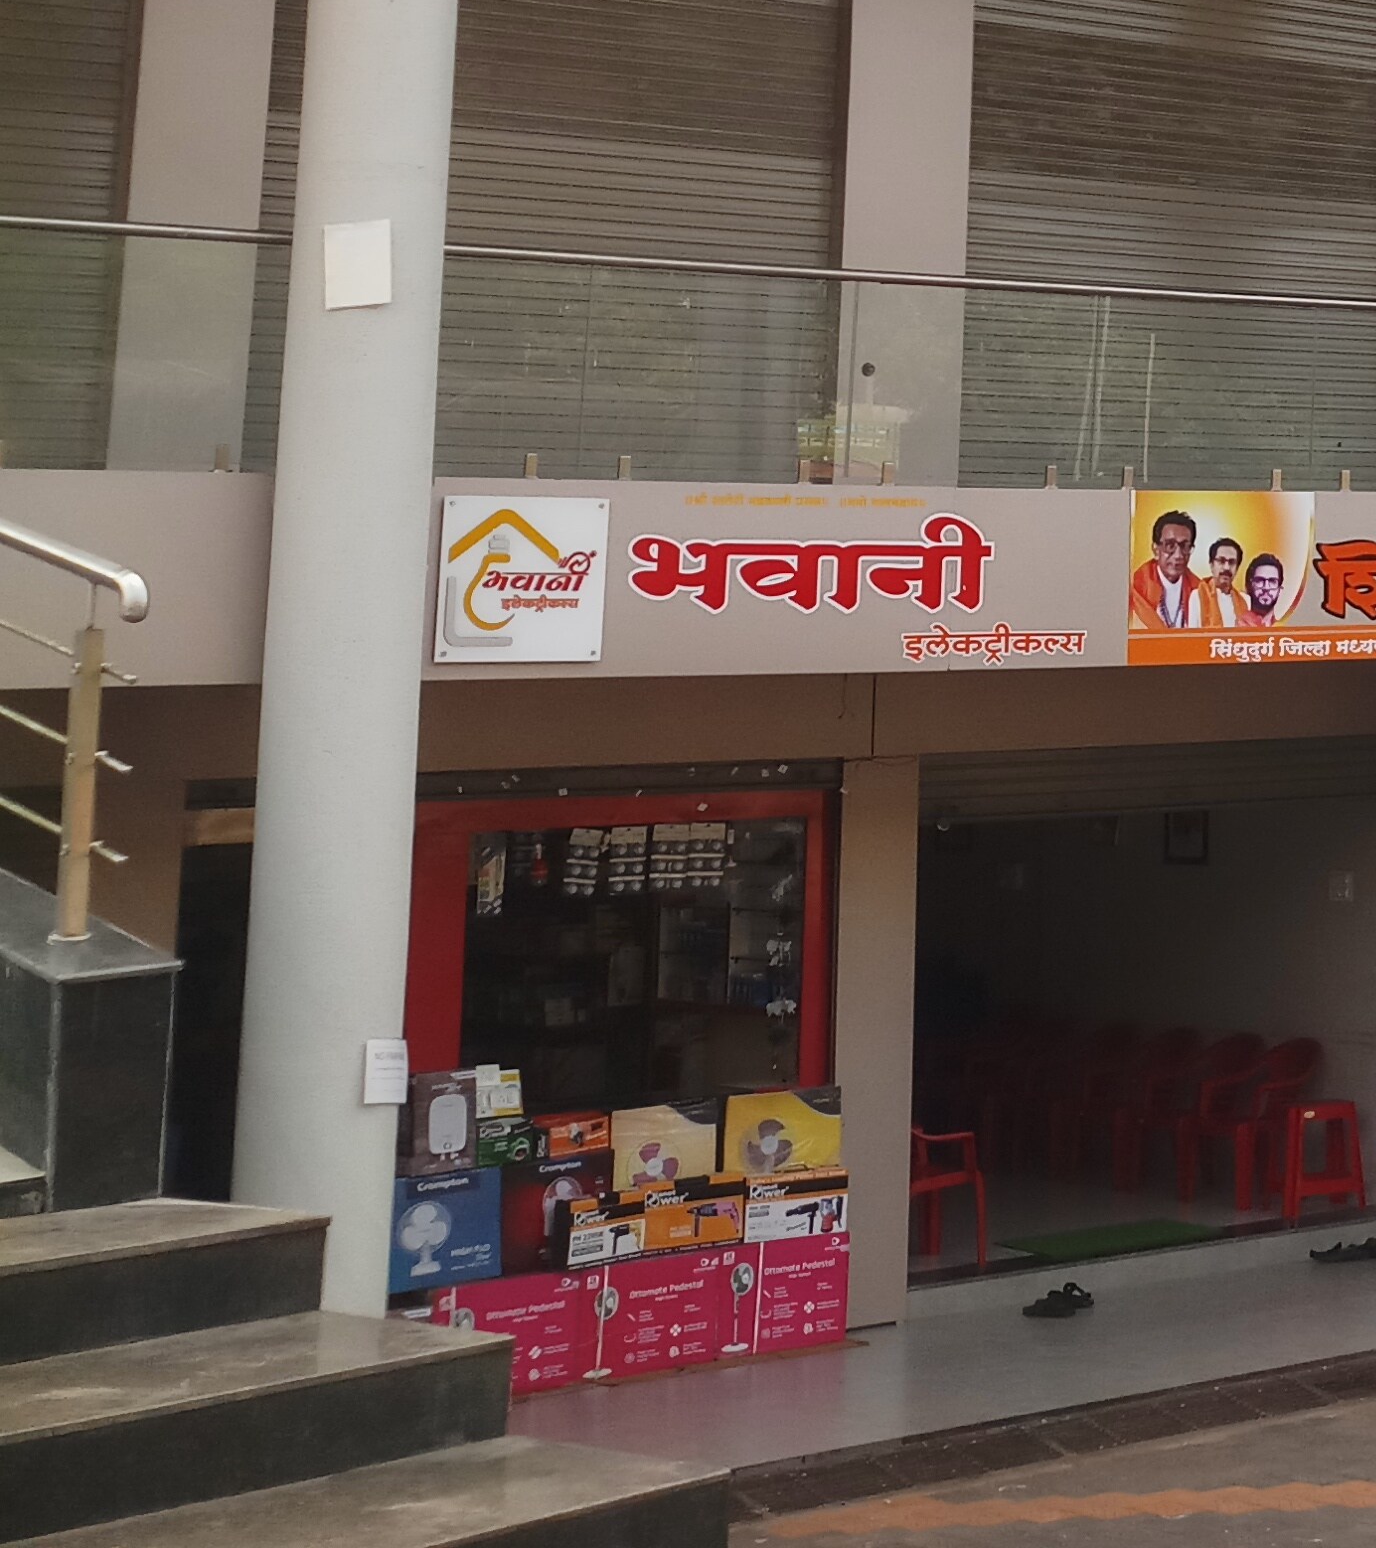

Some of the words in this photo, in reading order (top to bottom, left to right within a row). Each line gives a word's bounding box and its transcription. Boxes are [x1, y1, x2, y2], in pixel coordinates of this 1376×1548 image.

[482, 551, 592, 592] भवानी
[630, 512, 995, 614] भवानी
[1209, 637, 1274, 663] सिंधुदुर्ग
[1278, 636, 1330, 657] जिल्हा
[540, 1159, 582, 1175] Crompton
[416, 1176, 469, 1193] Crompton
[669, 1279, 704, 1294] Pedestal
